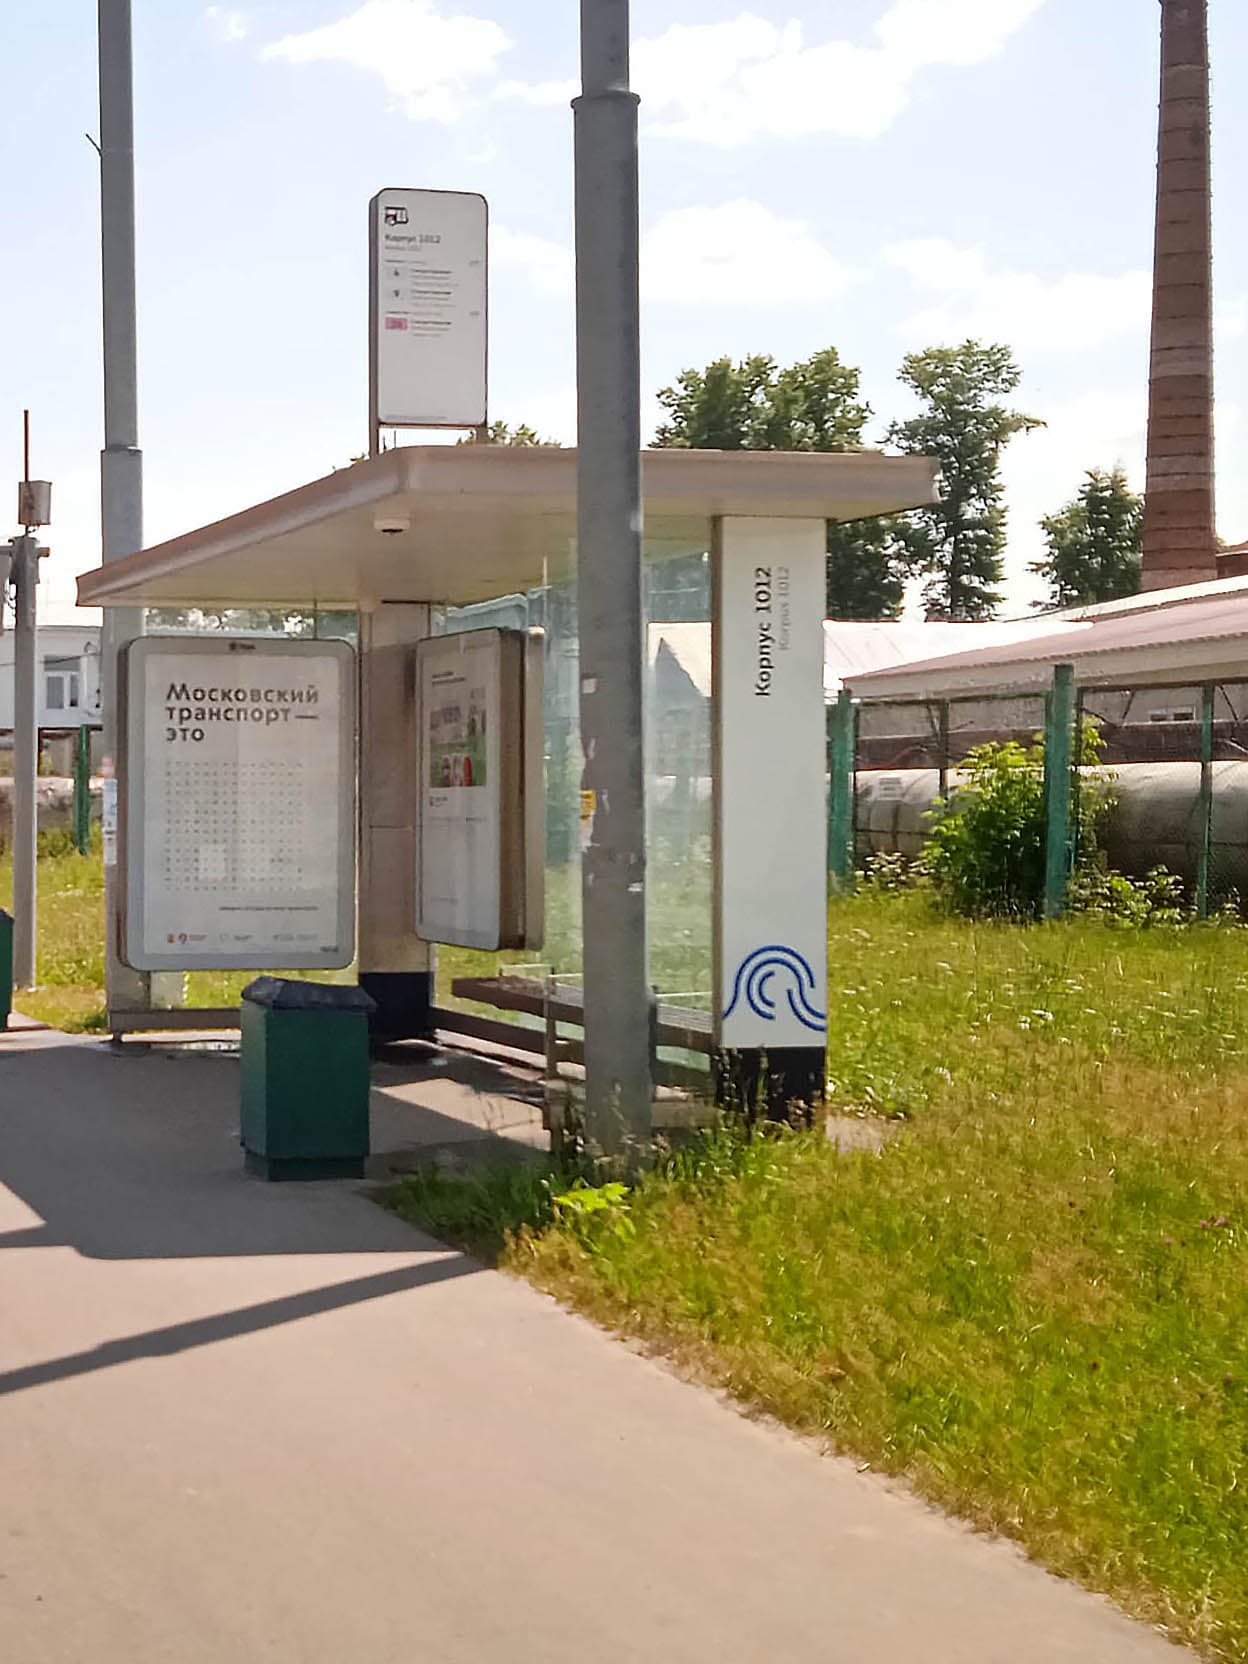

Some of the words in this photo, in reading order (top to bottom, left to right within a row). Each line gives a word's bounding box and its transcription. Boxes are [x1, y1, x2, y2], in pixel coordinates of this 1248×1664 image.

[755, 567, 772, 613] 1012
[778, 566, 790, 596] 1012
[755, 622, 776, 697] Корпус
[166, 682, 319, 704] Московский
[165, 706, 291, 726] транспорт
[166, 727, 205, 742] это
